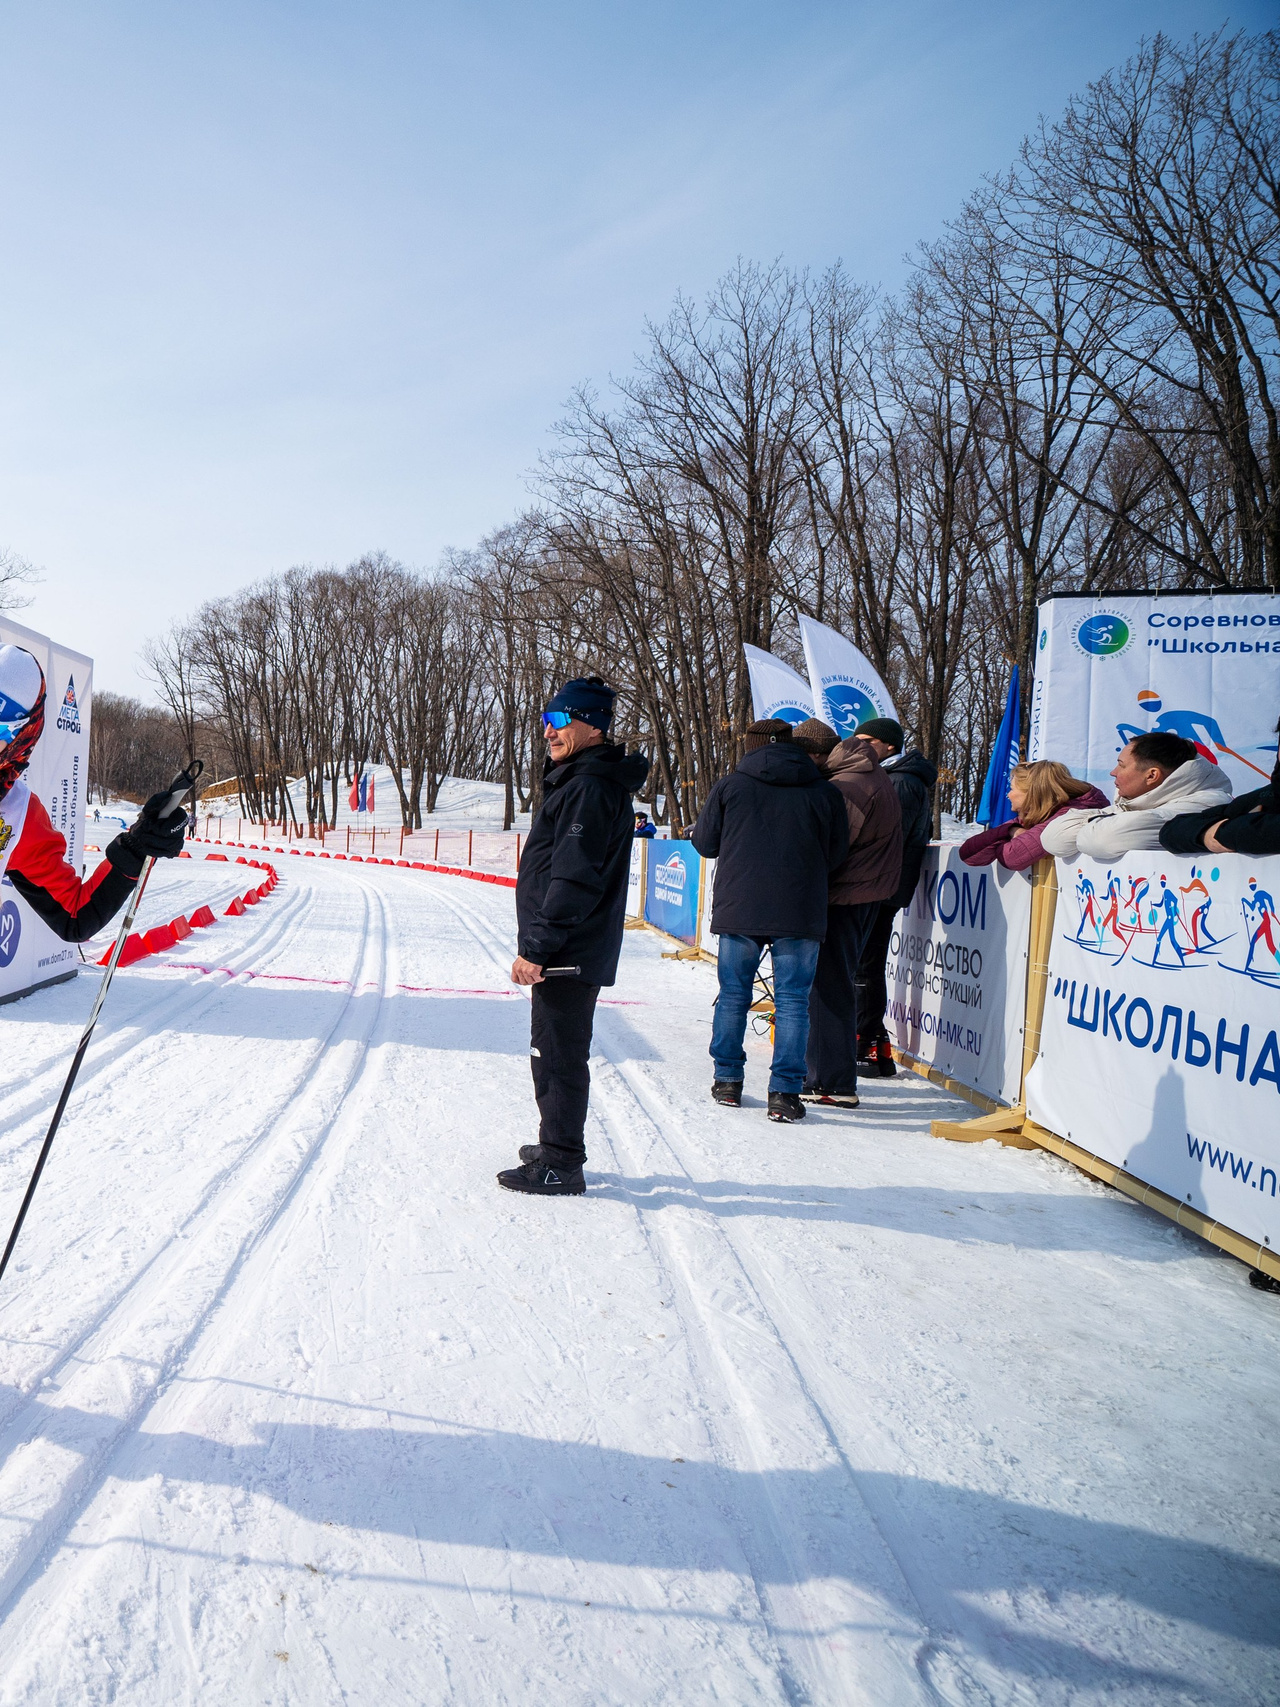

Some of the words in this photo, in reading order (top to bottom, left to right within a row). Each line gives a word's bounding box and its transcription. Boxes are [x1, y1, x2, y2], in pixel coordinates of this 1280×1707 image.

[1147, 612, 1280, 631] Соревнов
[821, 674, 854, 685] ЛЫЖНЫХ
[855, 679, 877, 699] ГОНОК
[58, 706, 80, 722] МЕГА
[56, 718, 81, 734] СТРОЙ
[70, 755, 80, 818] объектов
[60, 778, 69, 829] зданий
[37, 950, 74, 968] www.dom27.ru
[1186, 1132, 1280, 1197] www.n
